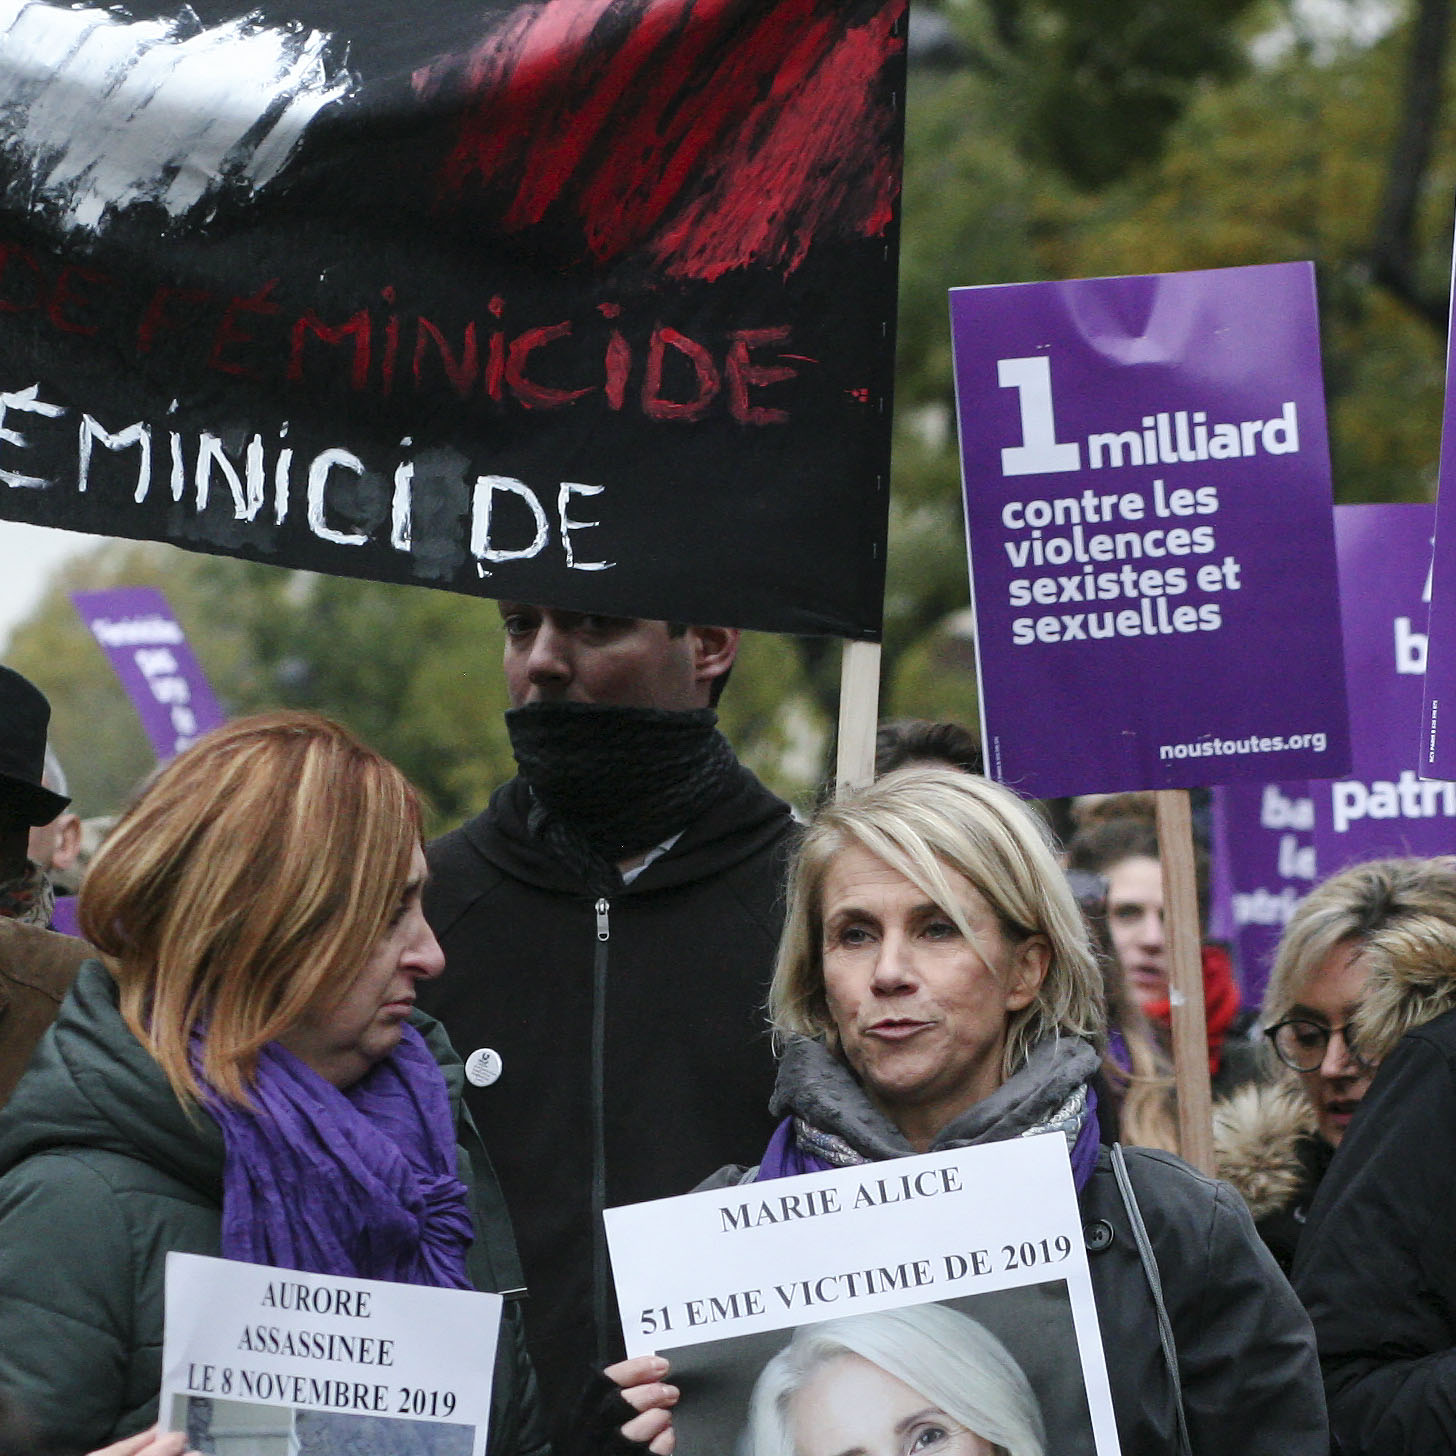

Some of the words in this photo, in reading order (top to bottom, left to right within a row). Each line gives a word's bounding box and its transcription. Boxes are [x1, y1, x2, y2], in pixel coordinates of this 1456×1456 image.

[997, 356, 1081, 476] 1
[1088, 401, 1300, 469] milliard
[1001, 489, 1145, 530] contre
[1153, 479, 1220, 518] les
[1004, 524, 1216, 568] violences
[1008, 564, 1189, 607] sexistes
[1196, 556, 1242, 593] et
[1012, 596, 1223, 646] sexuelles
[1159, 732, 1327, 760] noustoutes.org
[718, 1187, 842, 1233] MARIE
[851, 1166, 963, 1211] ALICE
[261, 1280, 372, 1319] AURORE
[640, 1305, 674, 1335] 51
[685, 1289, 766, 1328] EME
[773, 1259, 935, 1312] VICTIME
[942, 1249, 994, 1281] DE
[1003, 1234, 1072, 1272] 2019
[237, 1324, 394, 1367] ASSASSINEE
[187, 1362, 215, 1393] LE
[221, 1367, 233, 1395] 8
[239, 1369, 389, 1413] NOVEMBRE
[397, 1386, 456, 1418] 2019
